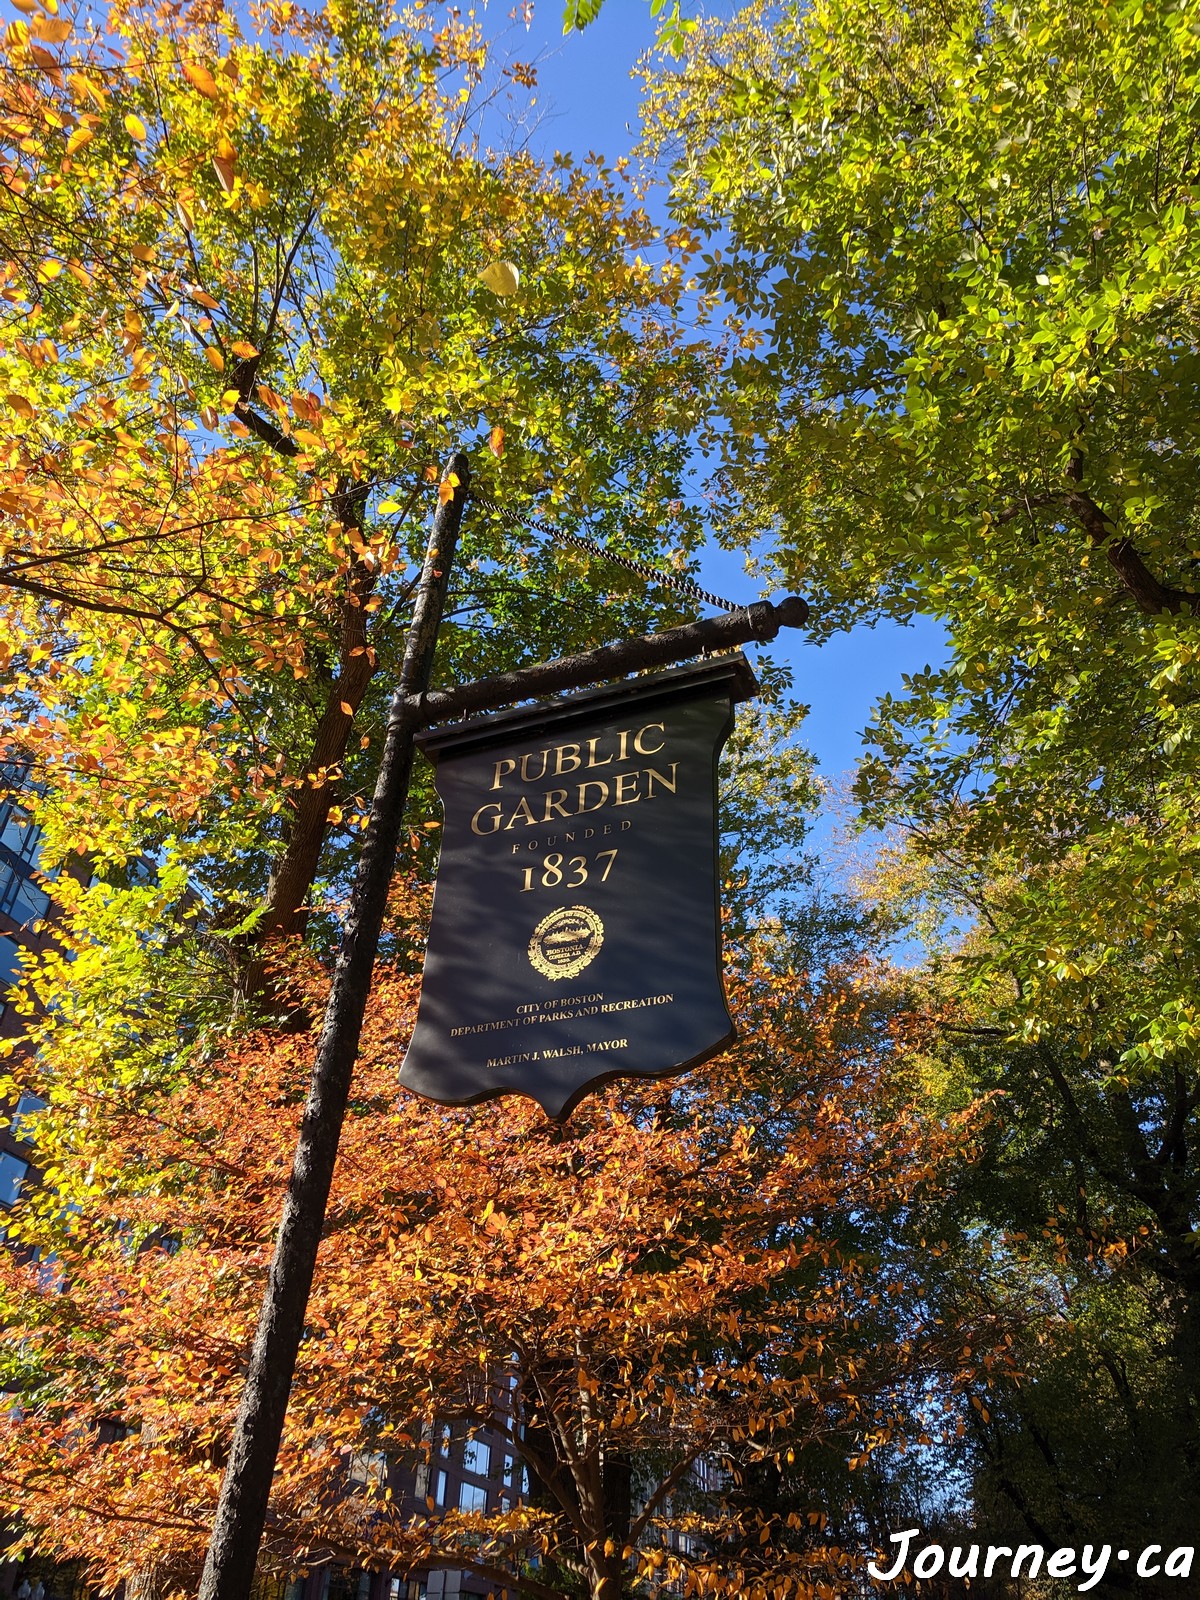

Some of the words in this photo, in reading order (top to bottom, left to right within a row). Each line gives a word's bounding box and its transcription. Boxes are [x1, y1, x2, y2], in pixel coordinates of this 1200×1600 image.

[489, 722, 665, 790] PUBLIC
[470, 762, 680, 836] GARDEN
[512, 820, 632, 854] FOUNDED
[520, 849, 618, 892] 1837
[450, 1018, 521, 1037] DEPARTMENT
[522, 1015, 538, 1026] OF
[539, 1010, 574, 1023] PARKS
[575, 1006, 598, 1018] AND
[600, 994, 674, 1013] RECREATION
[516, 1003, 541, 1014] CITY
[544, 1000, 558, 1010] OF
[560, 992, 604, 1008] BOSTON
[486, 1052, 530, 1068] MARTIN
[532, 1052, 540, 1061] J.
[542, 1046, 584, 1059] WALSH,
[586, 1038, 628, 1053] MAYOR
